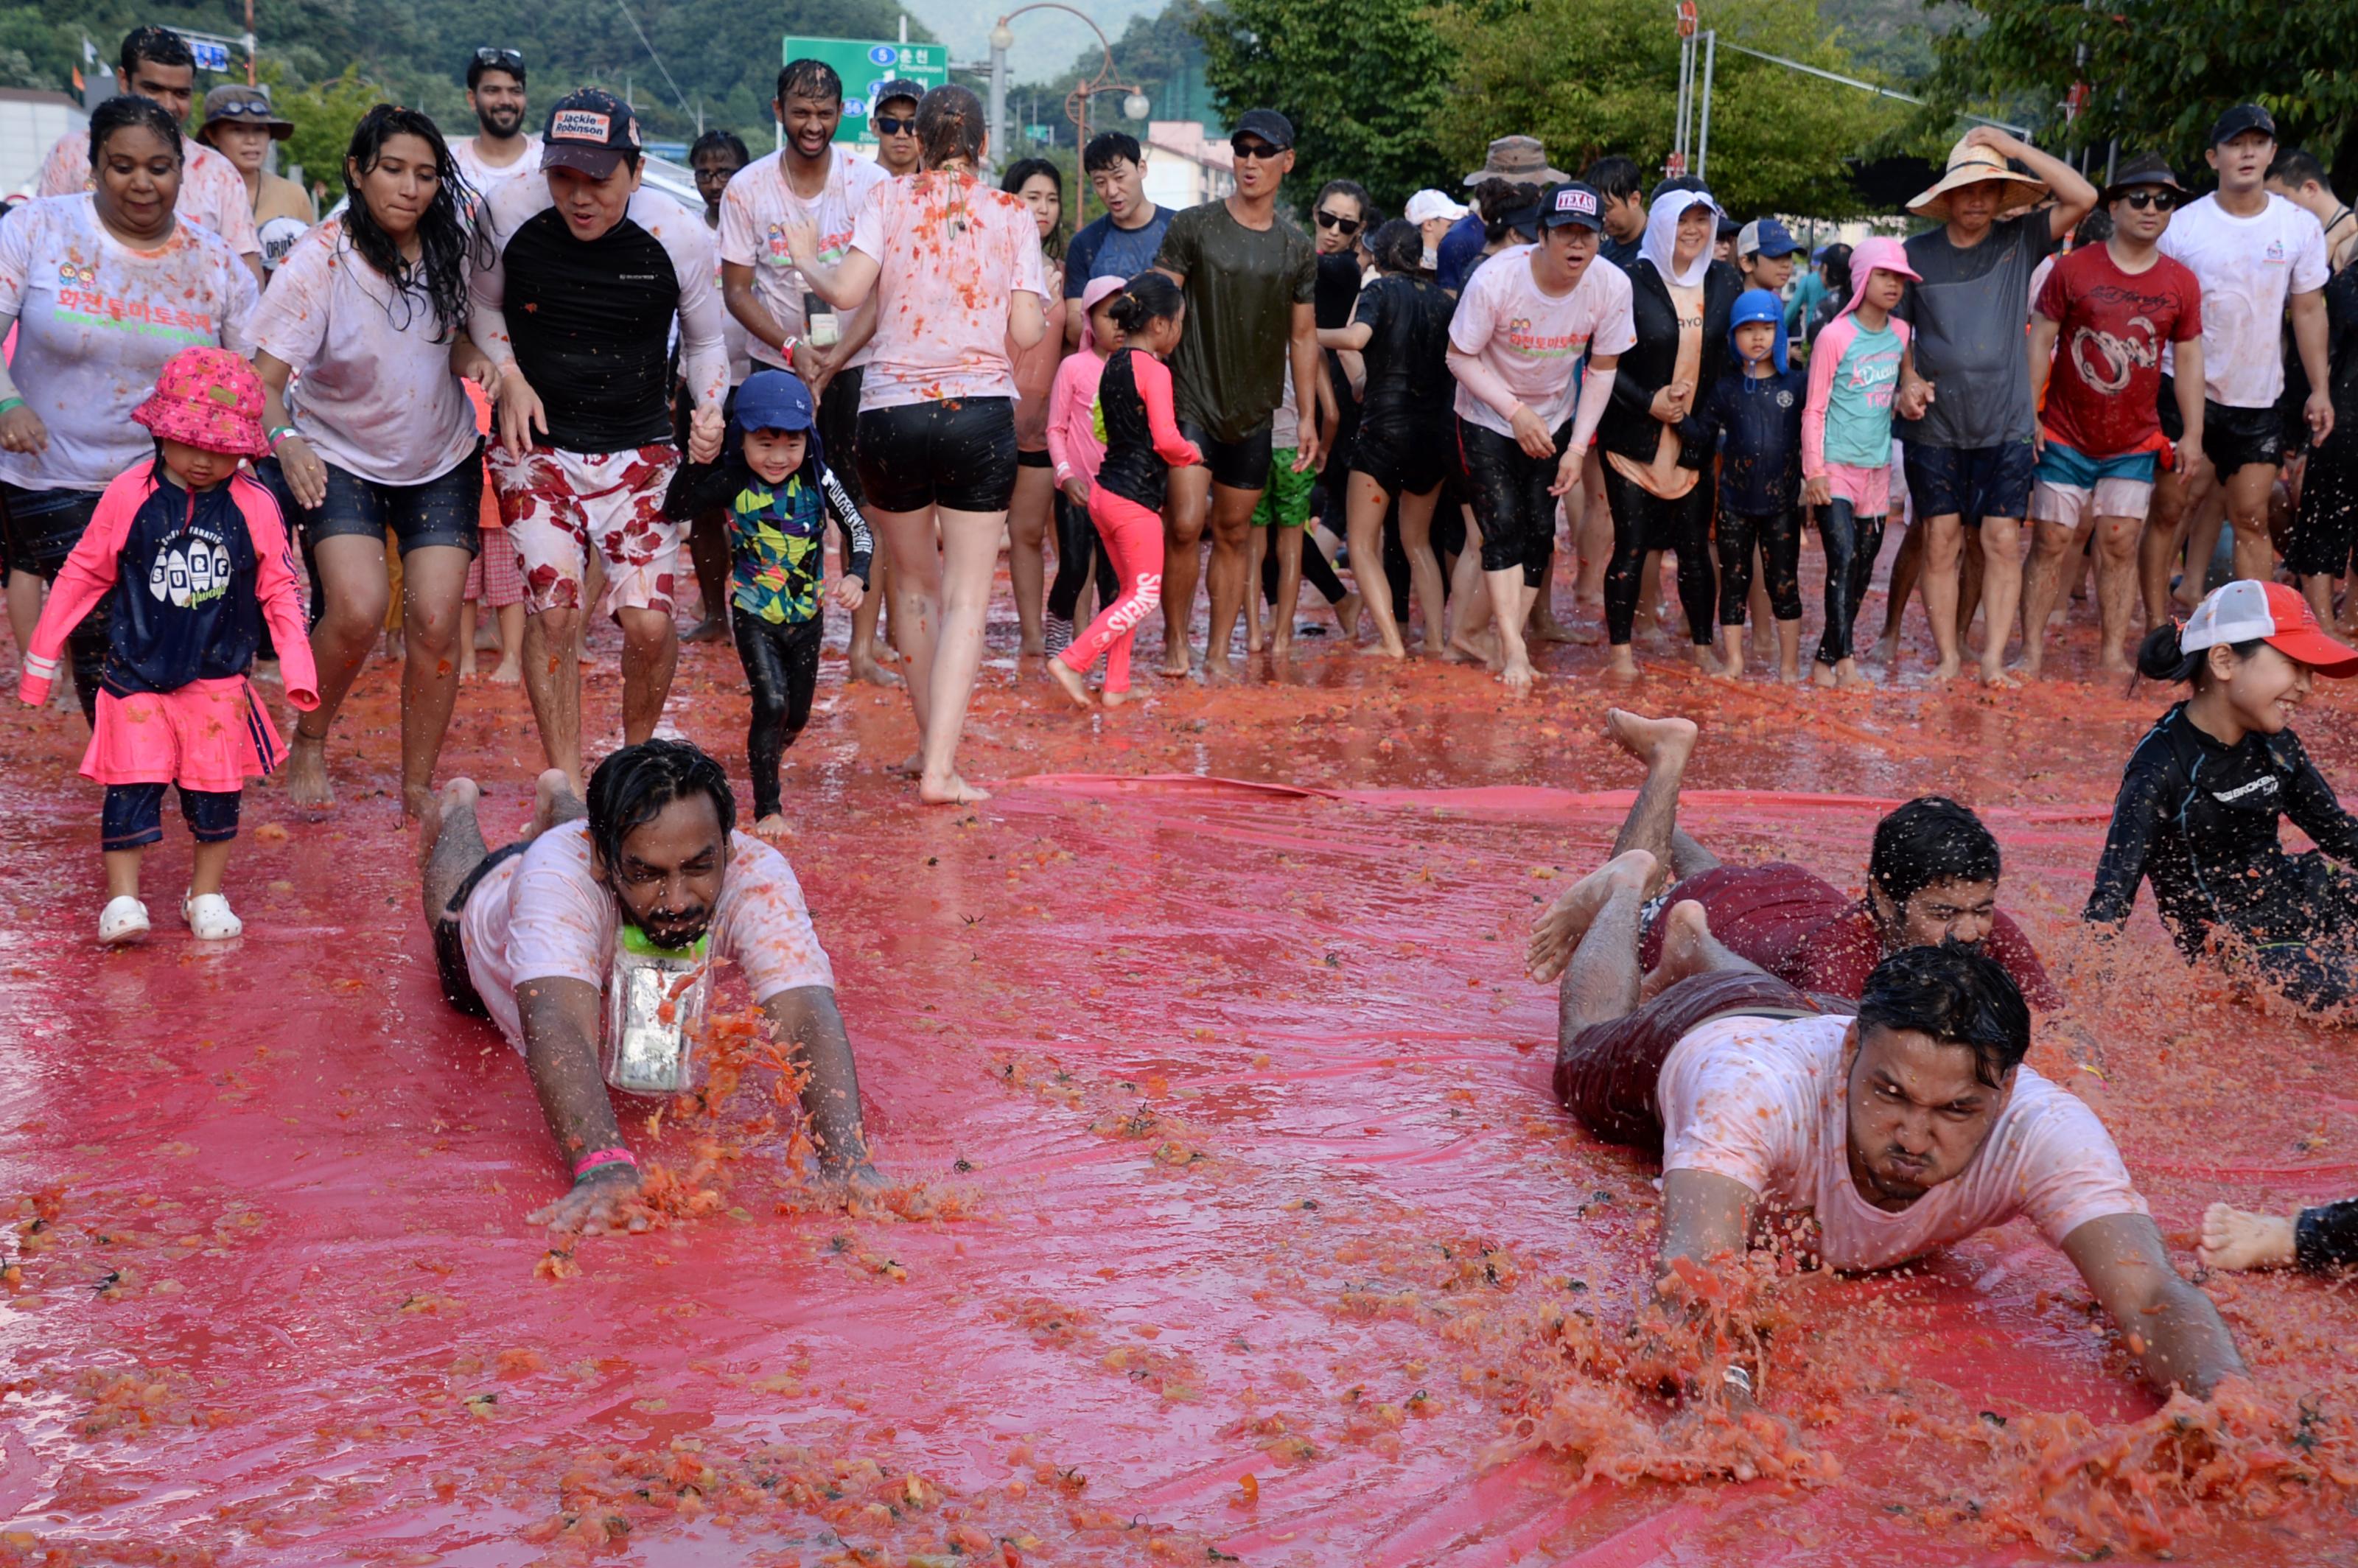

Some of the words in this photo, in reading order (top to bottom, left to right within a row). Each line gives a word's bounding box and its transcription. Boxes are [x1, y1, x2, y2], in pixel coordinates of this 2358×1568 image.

[878, 49, 889, 62] 5
[563, 114, 596, 125] Jackie
[556, 124, 603, 135] Robinson
[1558, 193, 1594, 210] TEXAS
[189, 525, 223, 545] FANATIC
